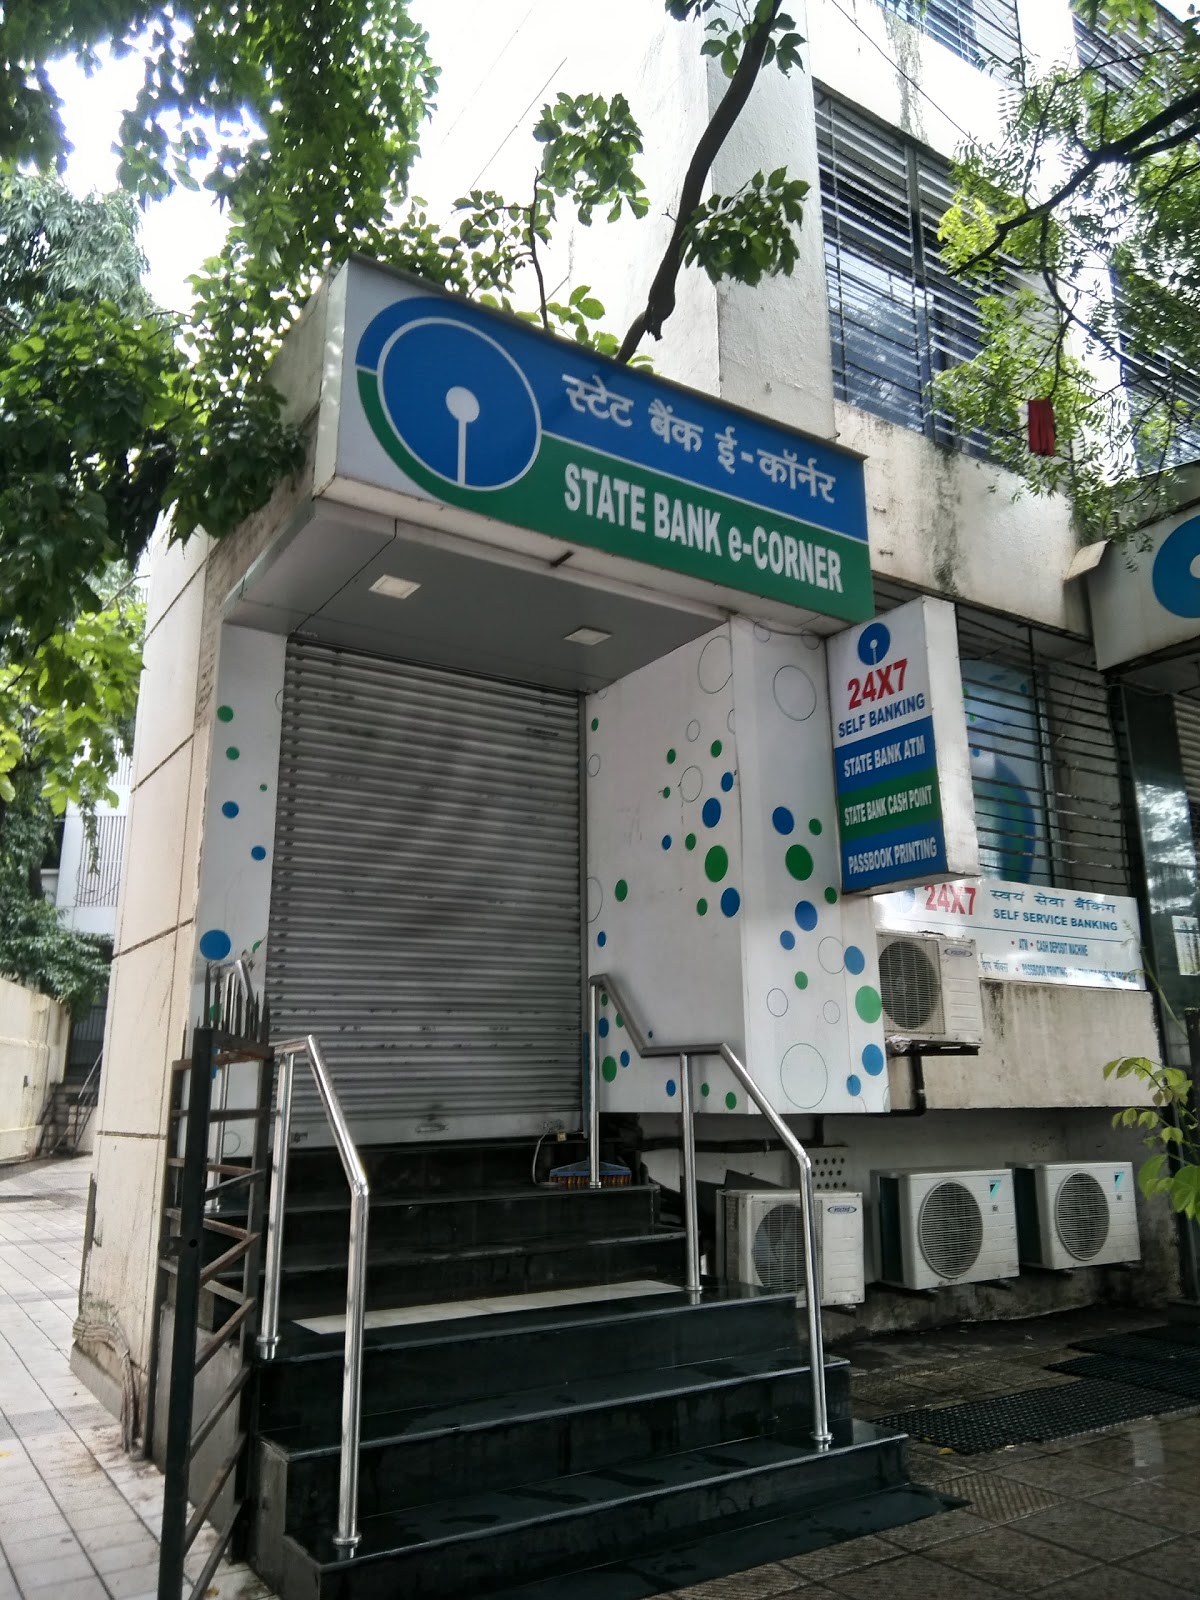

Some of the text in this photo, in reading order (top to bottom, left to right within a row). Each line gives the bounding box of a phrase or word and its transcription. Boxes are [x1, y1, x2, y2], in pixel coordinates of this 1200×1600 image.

[562, 374, 837, 503] स्टेट बैंक ई-कॉर्नर
[564, 463, 844, 593] STATE BANK e-CORNER
[847, 658, 908, 710] 24X7
[838, 692, 926, 738] SELF BANKING
[844, 735, 926, 778] STATE BANK ATM
[844, 785, 933, 827] STATE BANK CASH POINT
[848, 837, 937, 875] PASSBOOK PRINTING
[924, 884, 976, 915] 24X7
[993, 908, 1118, 931] SELF SERVICE BANKING
[1034, 892, 1067, 908] सेवा
[1036, 940, 1049, 952] CASH
[1049, 941, 1067, 954] DEPOSIT
